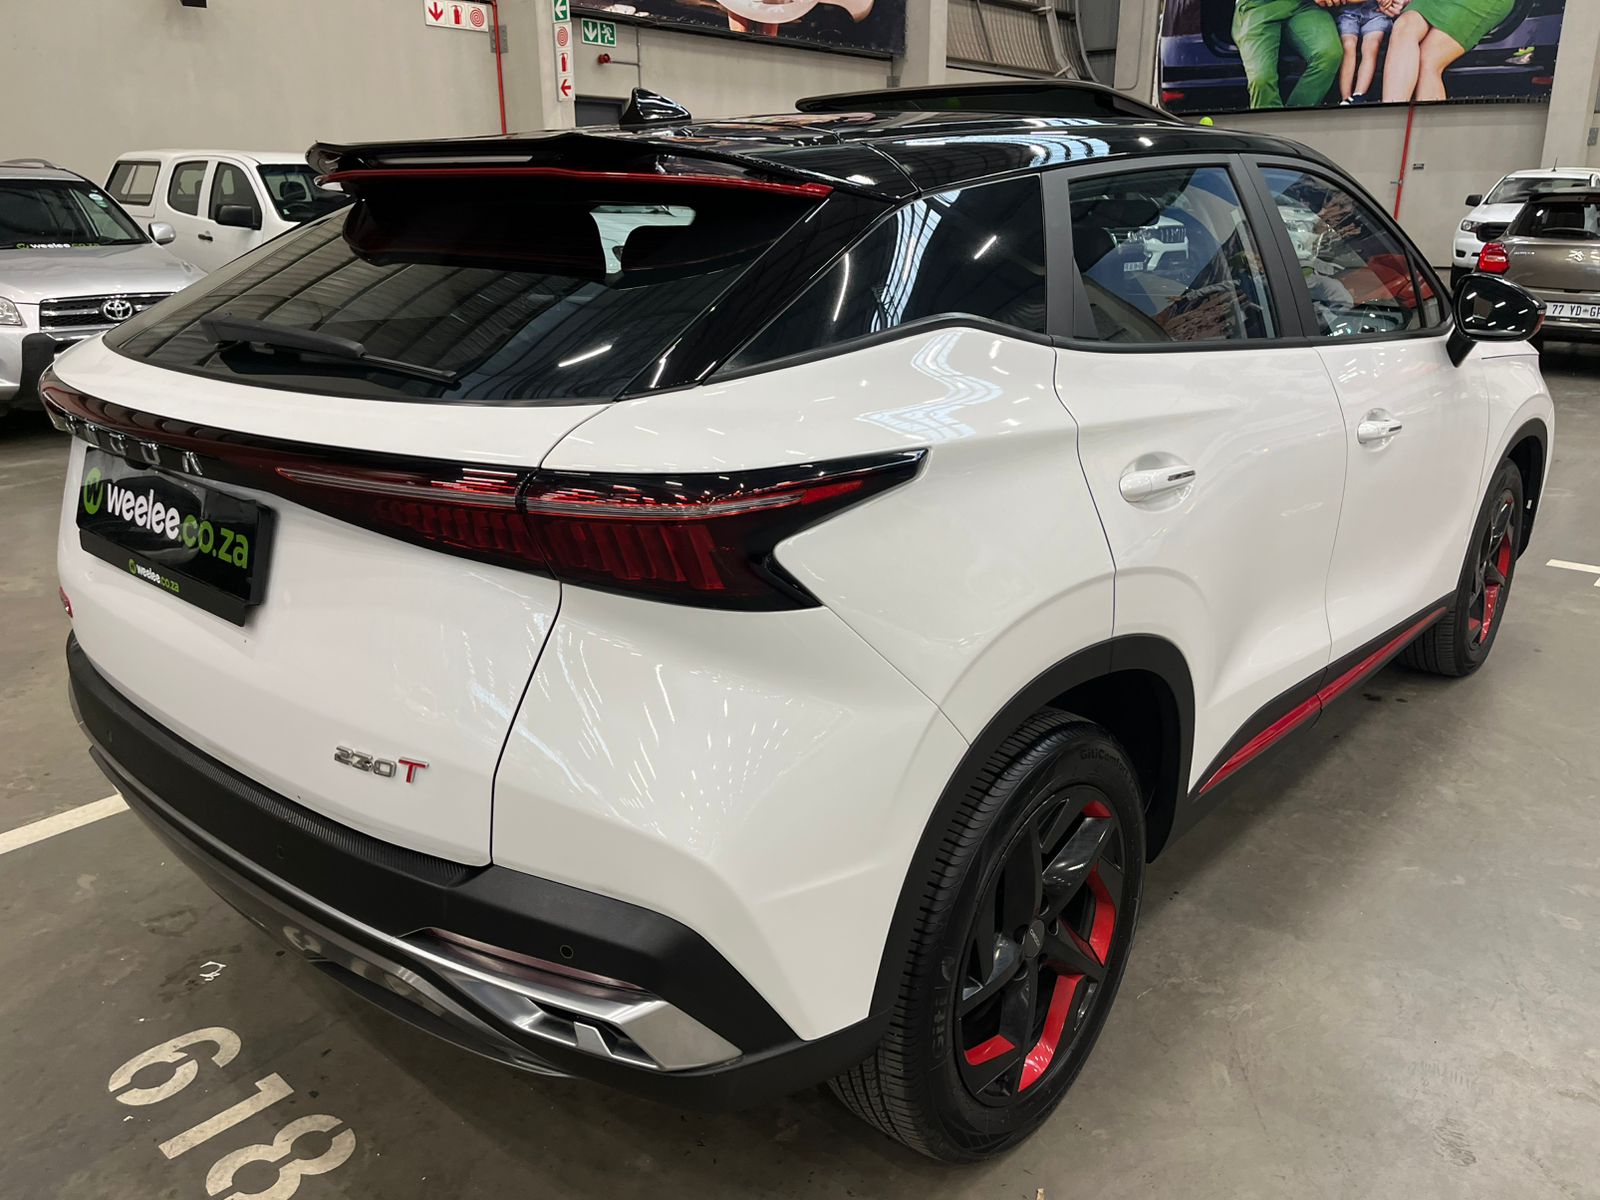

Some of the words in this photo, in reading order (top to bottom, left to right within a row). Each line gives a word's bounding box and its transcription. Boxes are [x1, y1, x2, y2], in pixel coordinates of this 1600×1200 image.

[1552, 304, 1565, 315] 77
[1570, 305, 1582, 316] YD
[107, 482, 249, 570] weelee.co.za
[333, 744, 430, 784] 230T
[108, 1026, 357, 1200] 618
